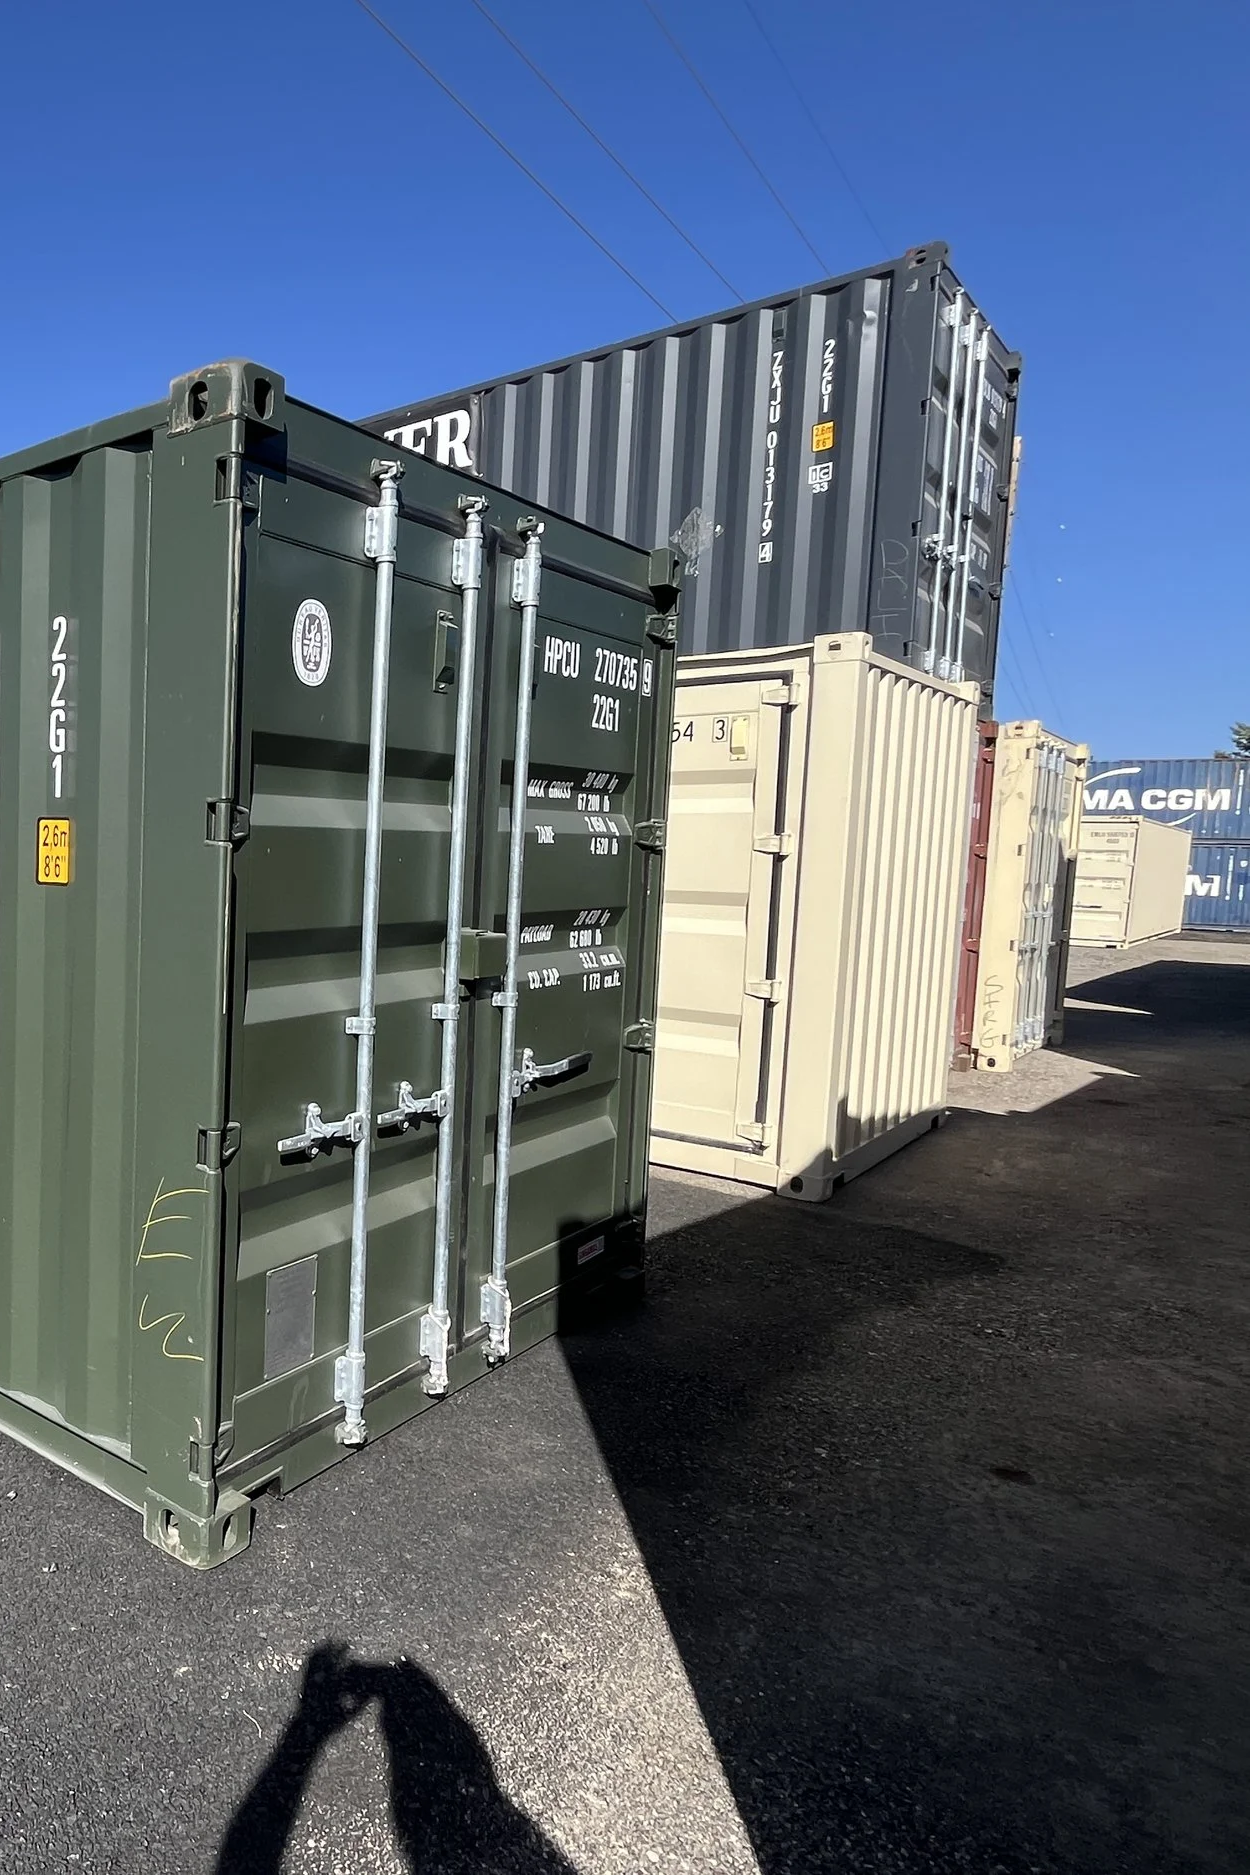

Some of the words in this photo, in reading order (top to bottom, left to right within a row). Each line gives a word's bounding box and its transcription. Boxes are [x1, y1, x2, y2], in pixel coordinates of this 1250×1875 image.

[770, 350, 784, 424] ZXJU
[821, 338, 836, 413] 22G1
[383, 409, 473, 468] ER
[761, 431, 778, 537] 013179
[812, 482, 829, 493] 33
[543, 635, 581, 679] HPCU
[594, 647, 639, 691] 270735
[642, 659, 653, 697] 9
[49, 615, 68, 798] 22G1
[591, 693, 620, 732] 22G1
[714, 718, 727, 742] 3
[1141, 788, 1231, 811] CGM
[520, 924, 554, 944] PAYLOAD
[527, 970, 543, 990] CU.
[542, 967, 561, 987] CAP.
